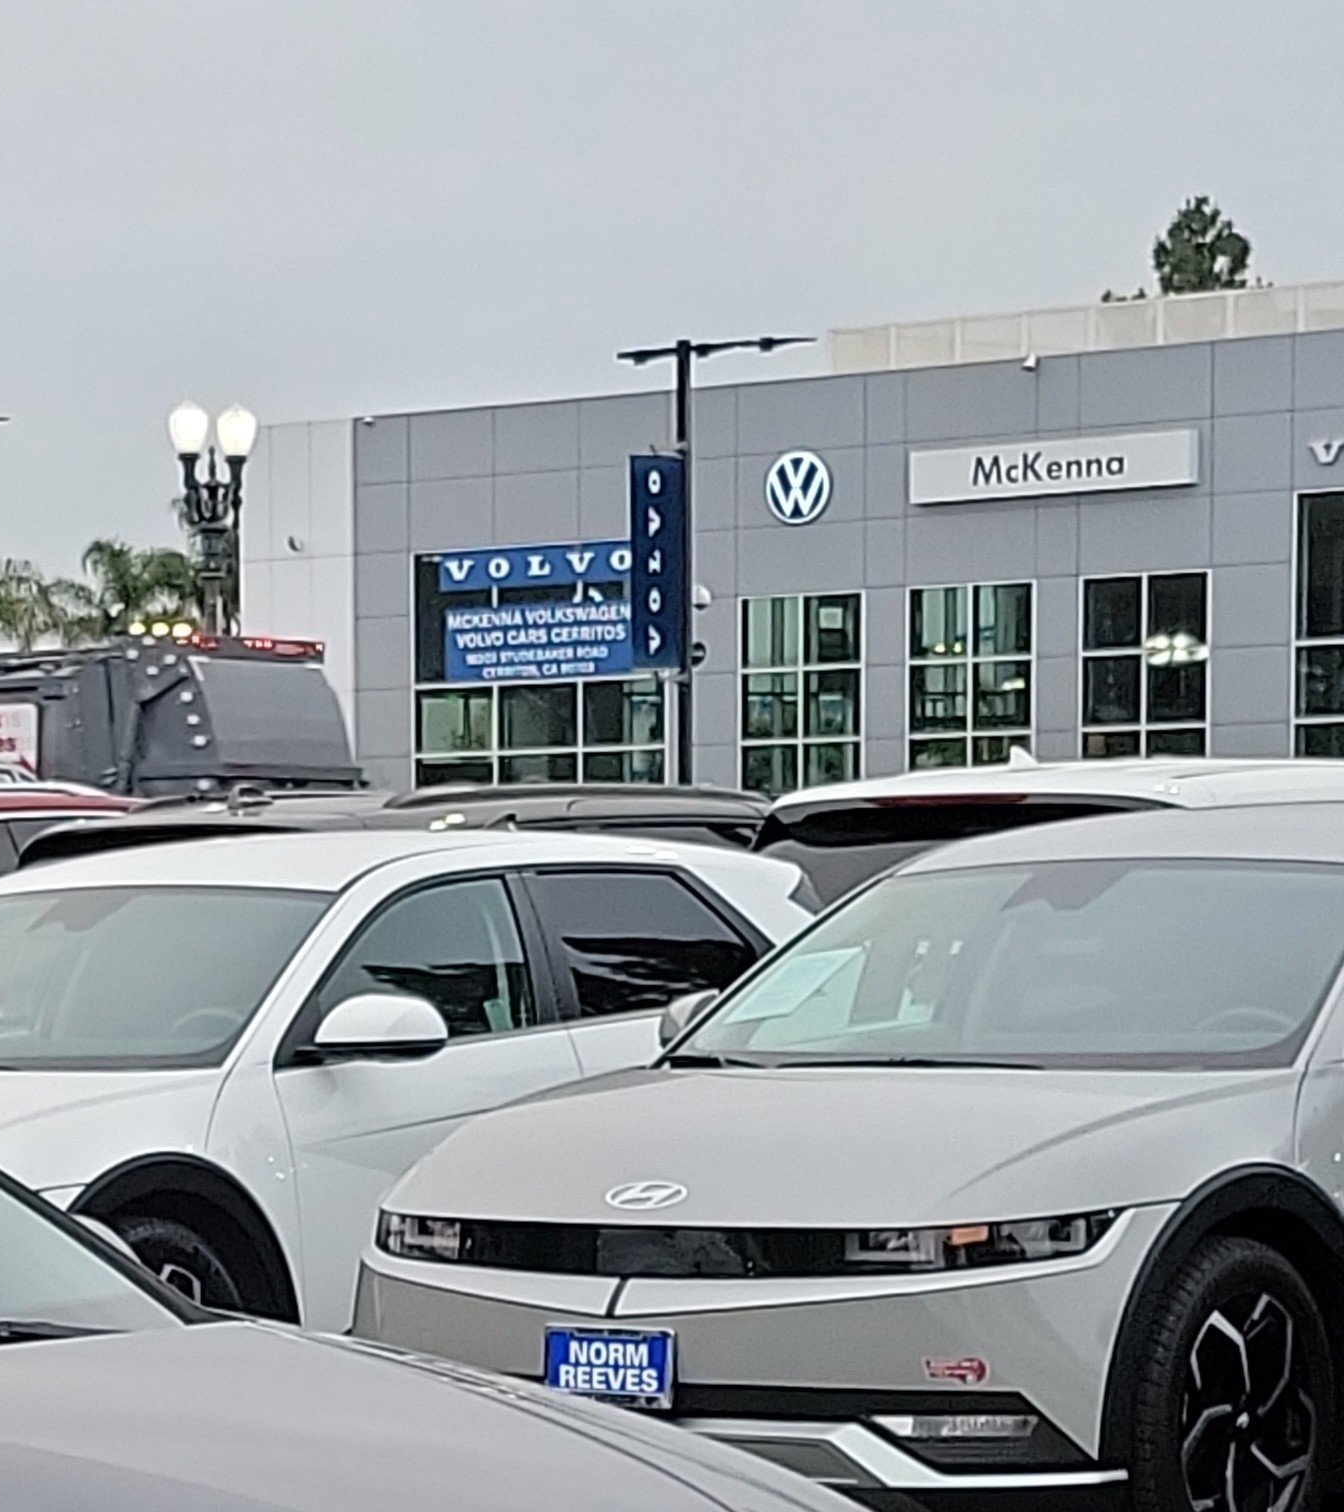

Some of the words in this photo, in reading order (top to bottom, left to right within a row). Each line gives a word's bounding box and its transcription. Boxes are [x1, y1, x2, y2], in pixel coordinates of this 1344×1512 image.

[972, 451, 1125, 487] McKenna
[444, 549, 632, 582] VOLVO
[648, 469, 661, 656] VOLVO
[447, 608, 523, 630] MCKENNA
[524, 603, 631, 626] VOLKSWAGEN
[456, 630, 504, 649] VOLVO
[507, 628, 548, 645] CARS
[550, 624, 627, 643] CERRITOS
[569, 1340, 649, 1367] NORM
[559, 1364, 659, 1393] REEVES
